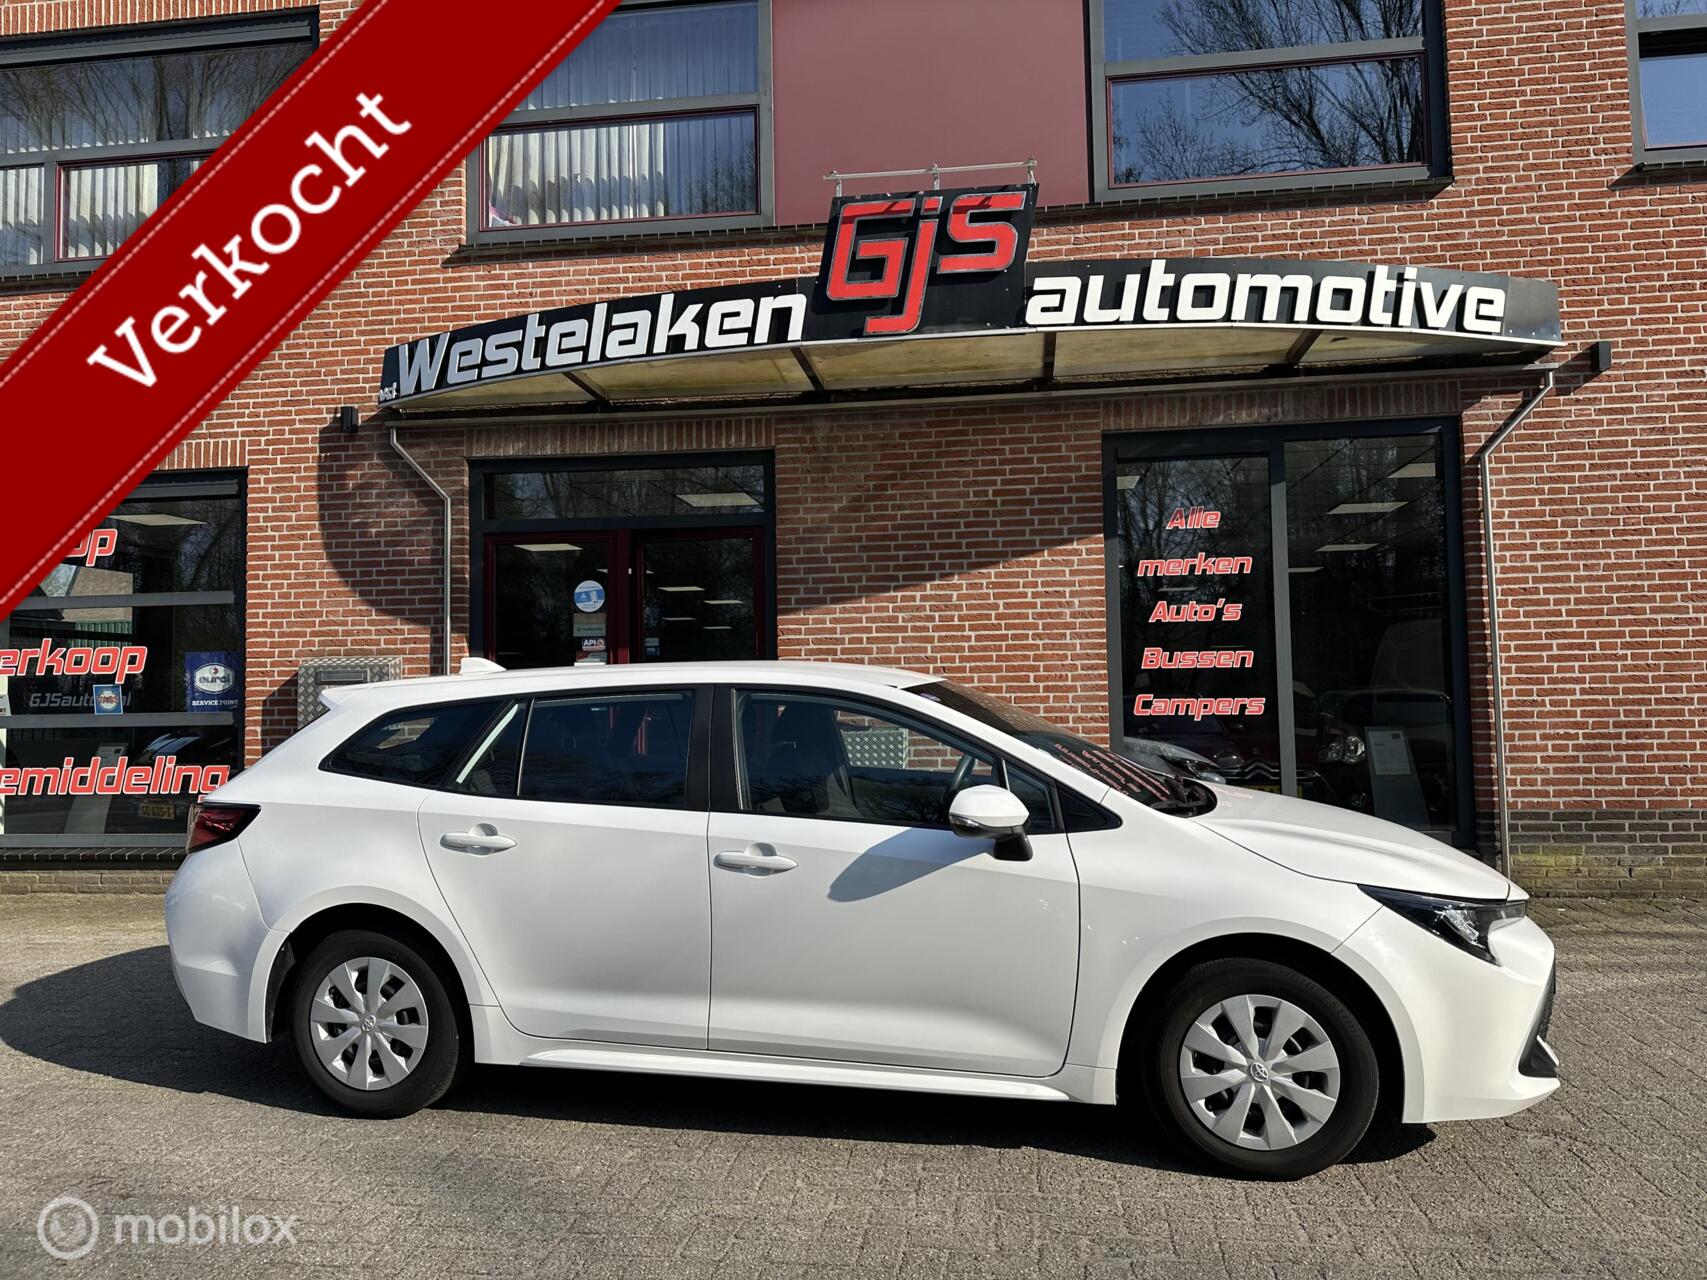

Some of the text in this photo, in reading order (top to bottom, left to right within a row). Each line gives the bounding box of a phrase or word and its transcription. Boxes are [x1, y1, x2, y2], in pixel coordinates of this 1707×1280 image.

[398, 293, 807, 396] Westelaken
[1024, 259, 1507, 334] automotive
[1165, 506, 1222, 530] Alle
[1137, 552, 1253, 577] merken
[1148, 598, 1243, 623] Auto's
[0, 637, 148, 684] erkoop
[1141, 647, 1254, 670] Bussen
[1133, 694, 1266, 721] Campers
[0, 755, 231, 803] emiddeling
